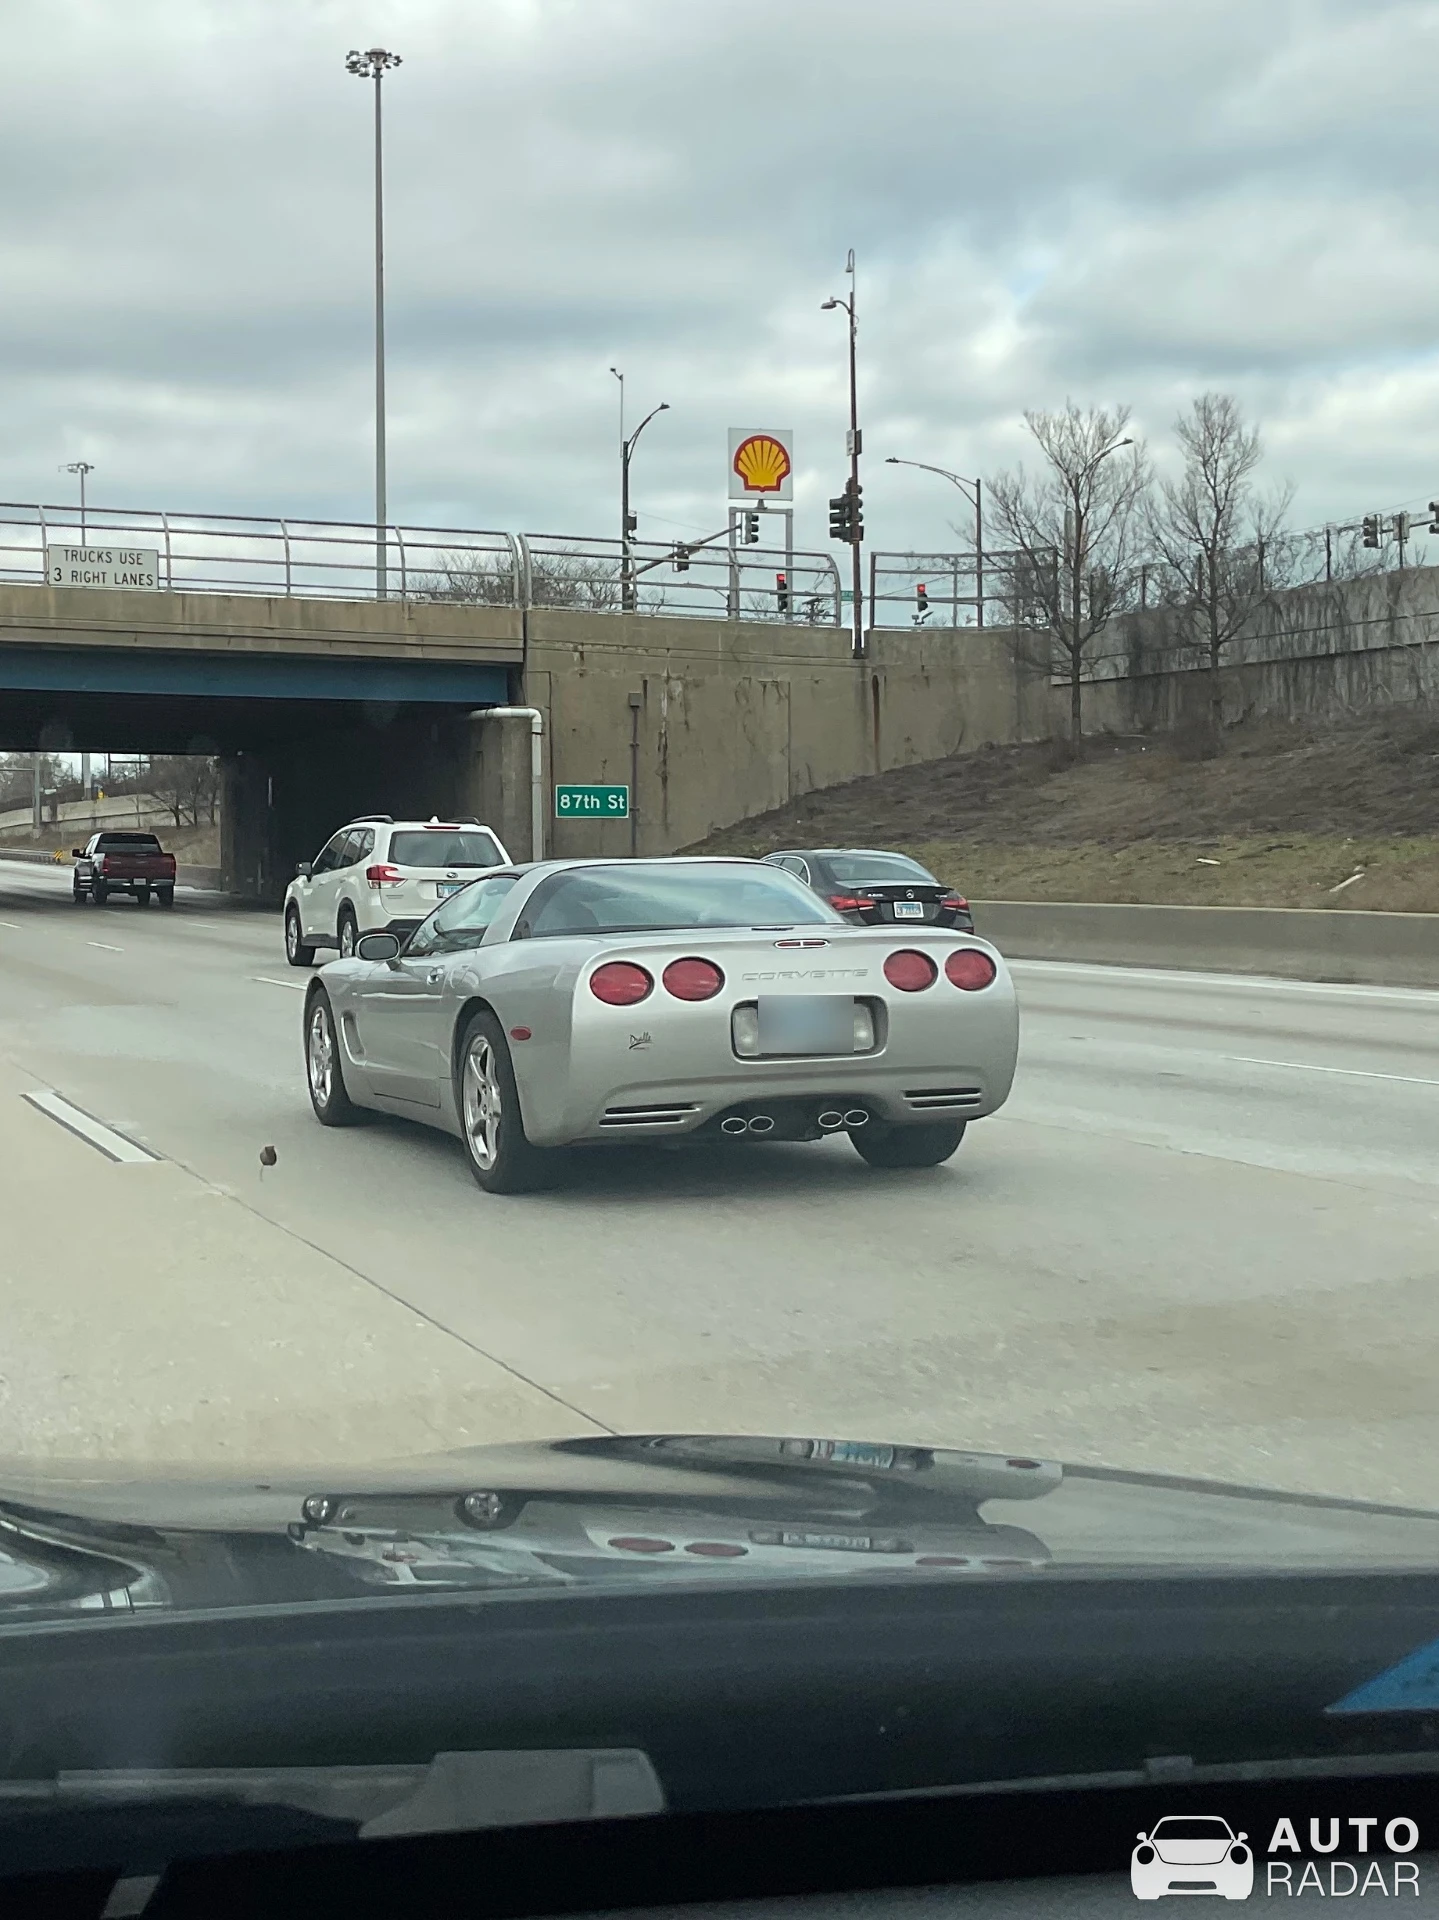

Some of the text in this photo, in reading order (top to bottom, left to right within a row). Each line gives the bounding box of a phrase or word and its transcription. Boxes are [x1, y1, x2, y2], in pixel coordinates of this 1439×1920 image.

[64, 549, 143, 565] TRUCKS USE
[53, 568, 153, 586] 3 RIGHT LANES
[560, 794, 625, 809] 87th St
[742, 969, 869, 981] CORVETTE
